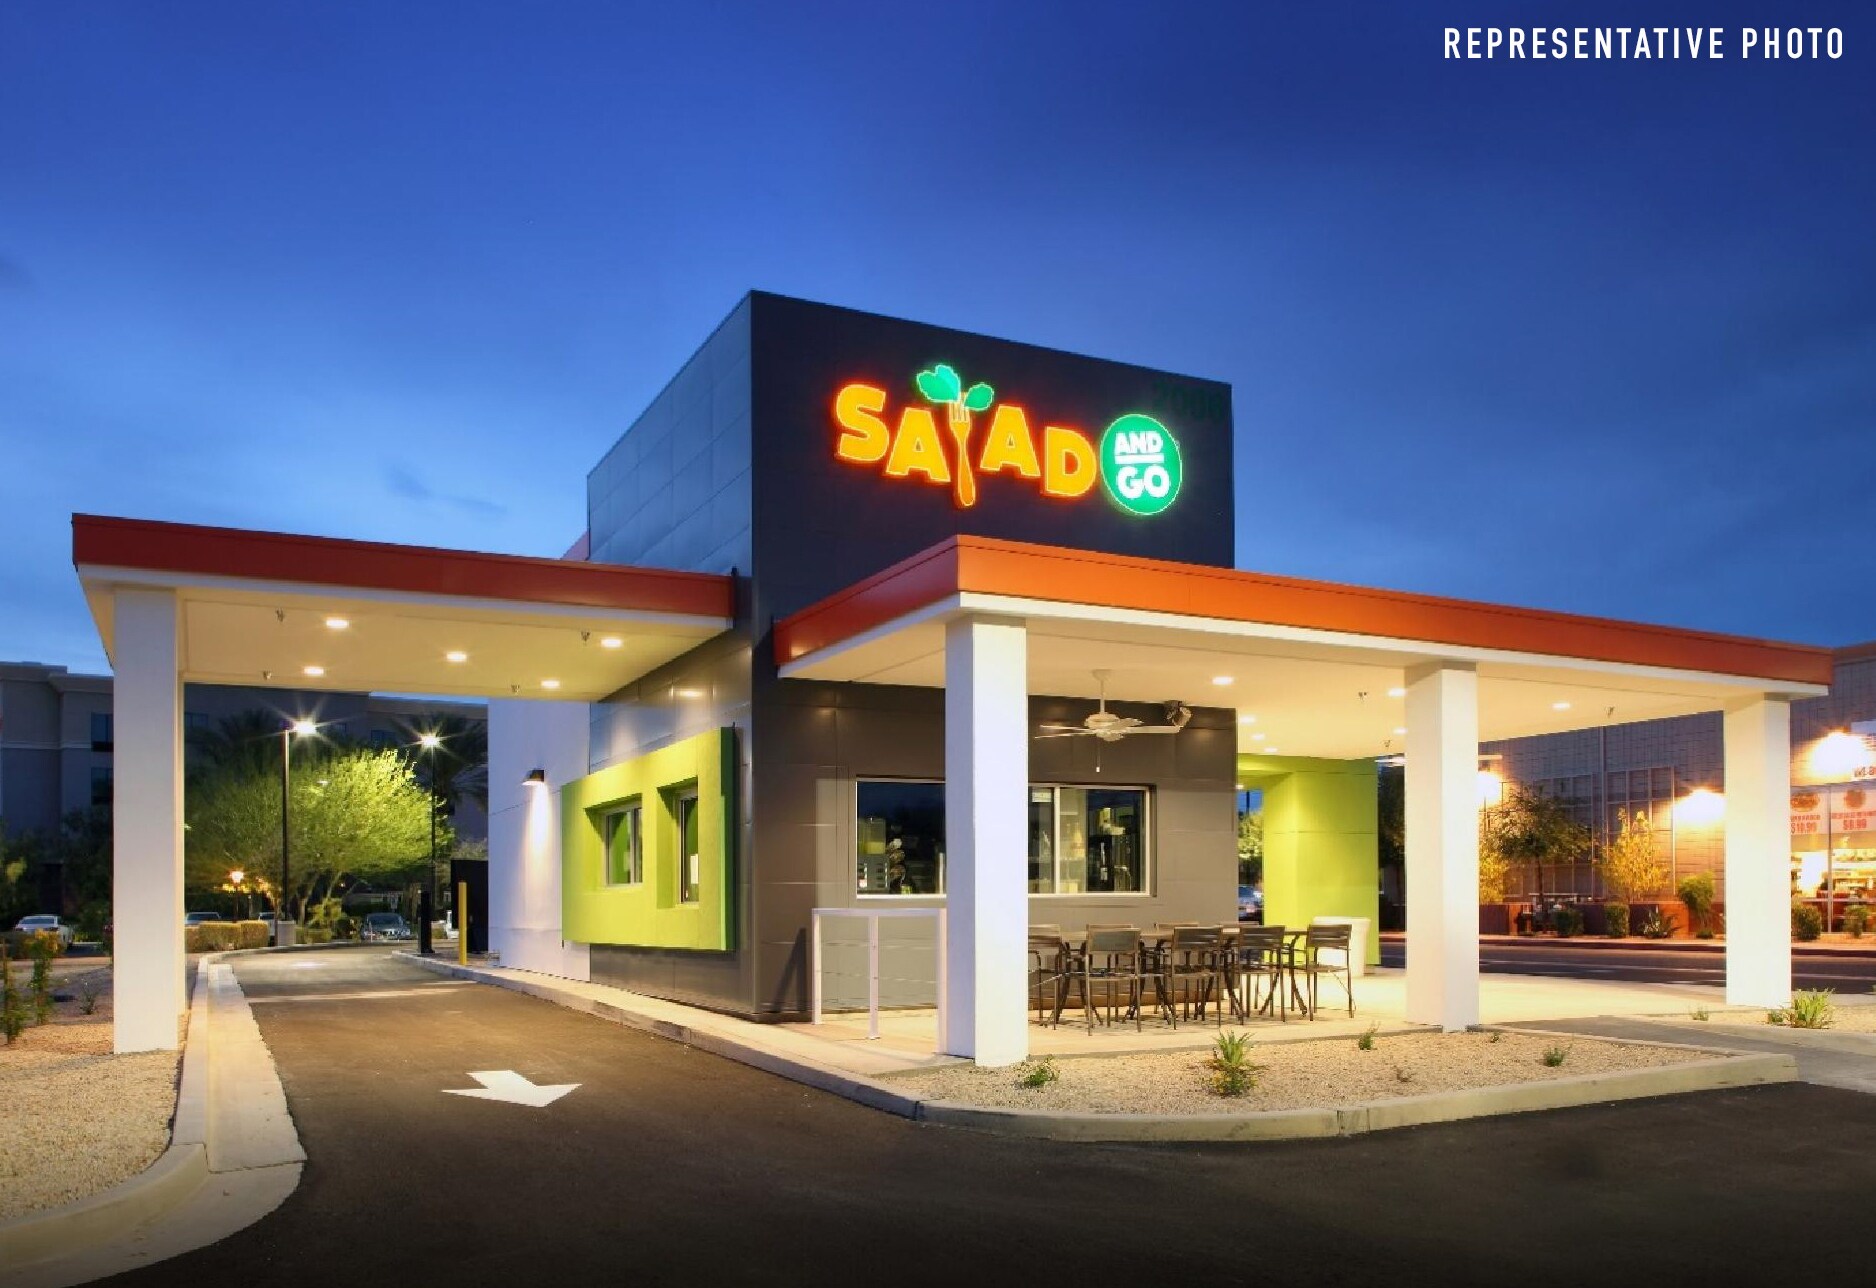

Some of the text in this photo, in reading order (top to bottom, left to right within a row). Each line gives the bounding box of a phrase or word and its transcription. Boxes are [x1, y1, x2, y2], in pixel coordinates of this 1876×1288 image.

[835, 370, 1097, 507] SALAD
[1114, 430, 1164, 455] AND
[1115, 465, 1171, 500] GO
